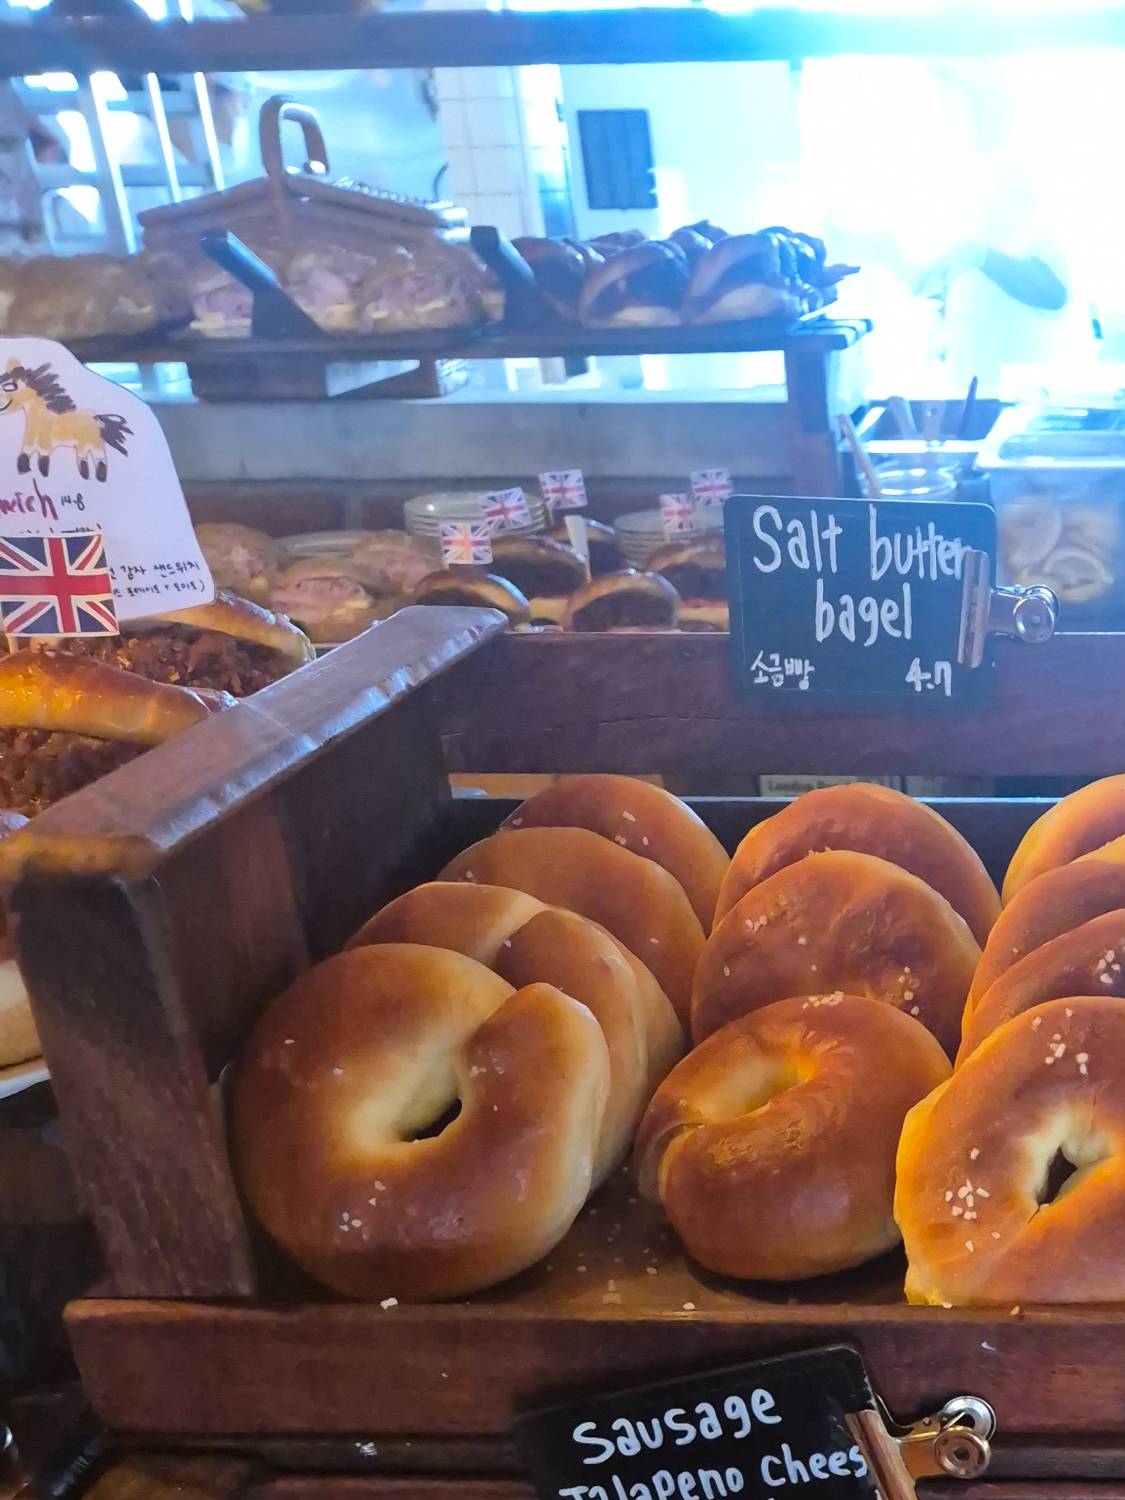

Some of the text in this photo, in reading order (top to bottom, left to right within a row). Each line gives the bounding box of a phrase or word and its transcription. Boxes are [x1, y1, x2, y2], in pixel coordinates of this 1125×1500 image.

[753, 505, 843, 573] Salt
[815, 578, 913, 647] bagel
[751, 650, 815, 690] 소금빵
[905, 657, 953, 696] 4.7
[572, 1388, 782, 1465] Sausage
